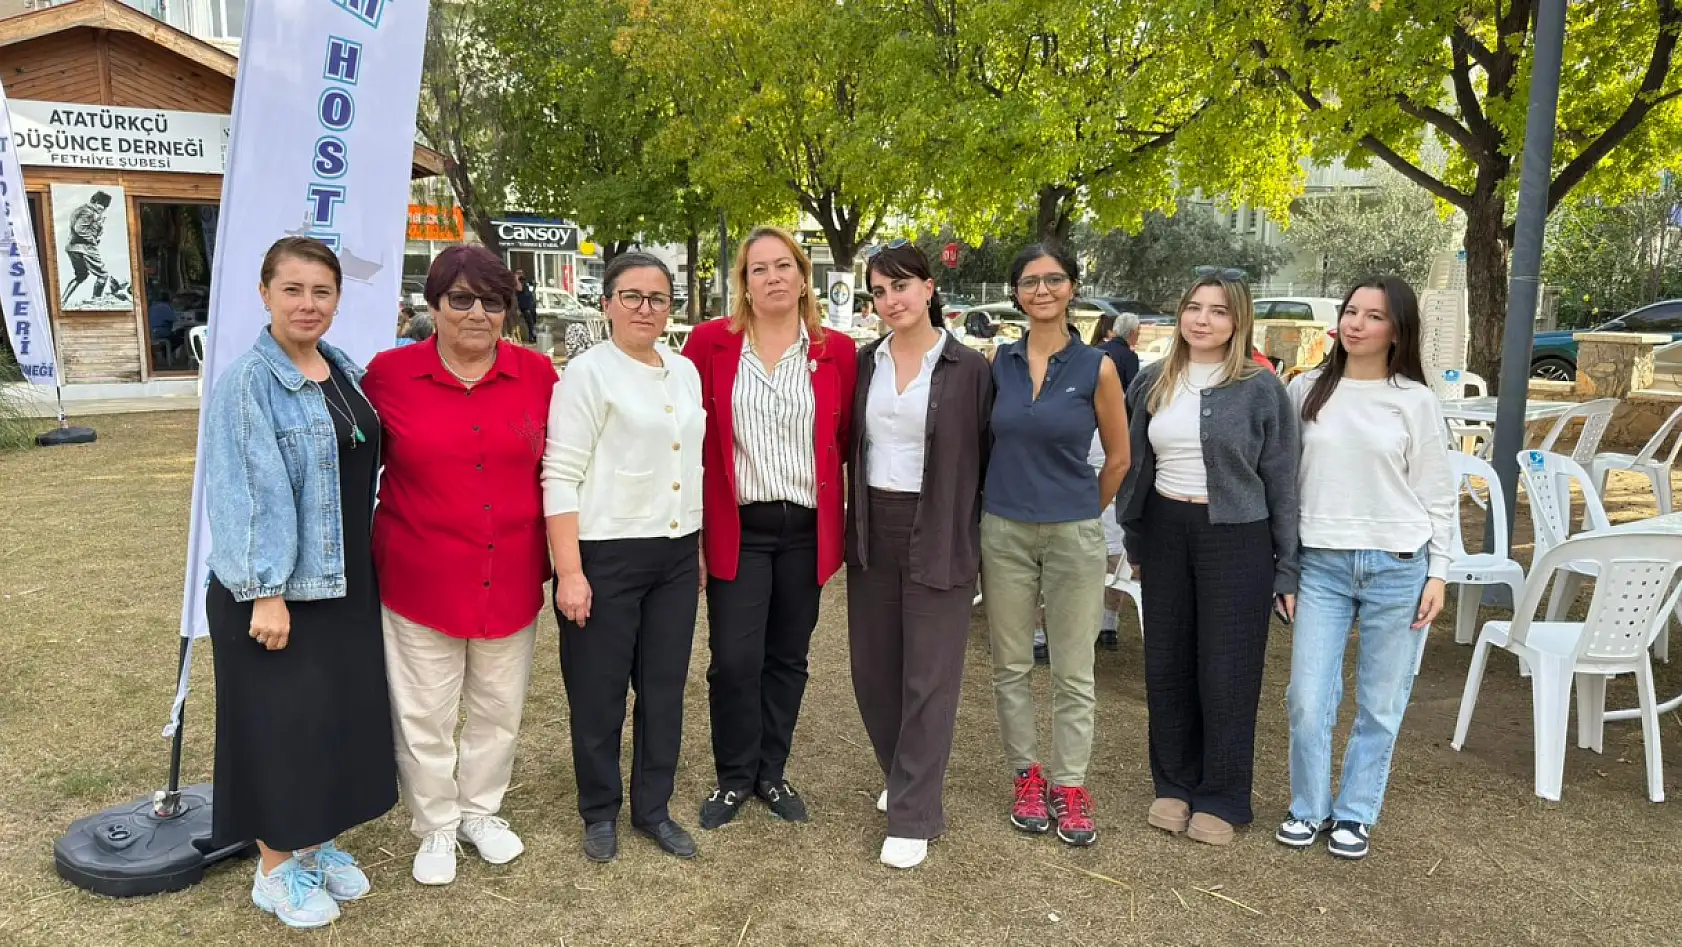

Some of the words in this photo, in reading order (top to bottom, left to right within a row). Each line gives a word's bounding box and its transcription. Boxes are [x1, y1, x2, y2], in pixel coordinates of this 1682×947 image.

[50, 109, 167, 136] ATATÜRKÇÜ
[14, 128, 113, 153] DÜŞÜNCE
[118, 137, 204, 158] DERNEĞİ
[51, 153, 114, 167] FETHİYE
[119, 156, 171, 169] ŞUBESİ
